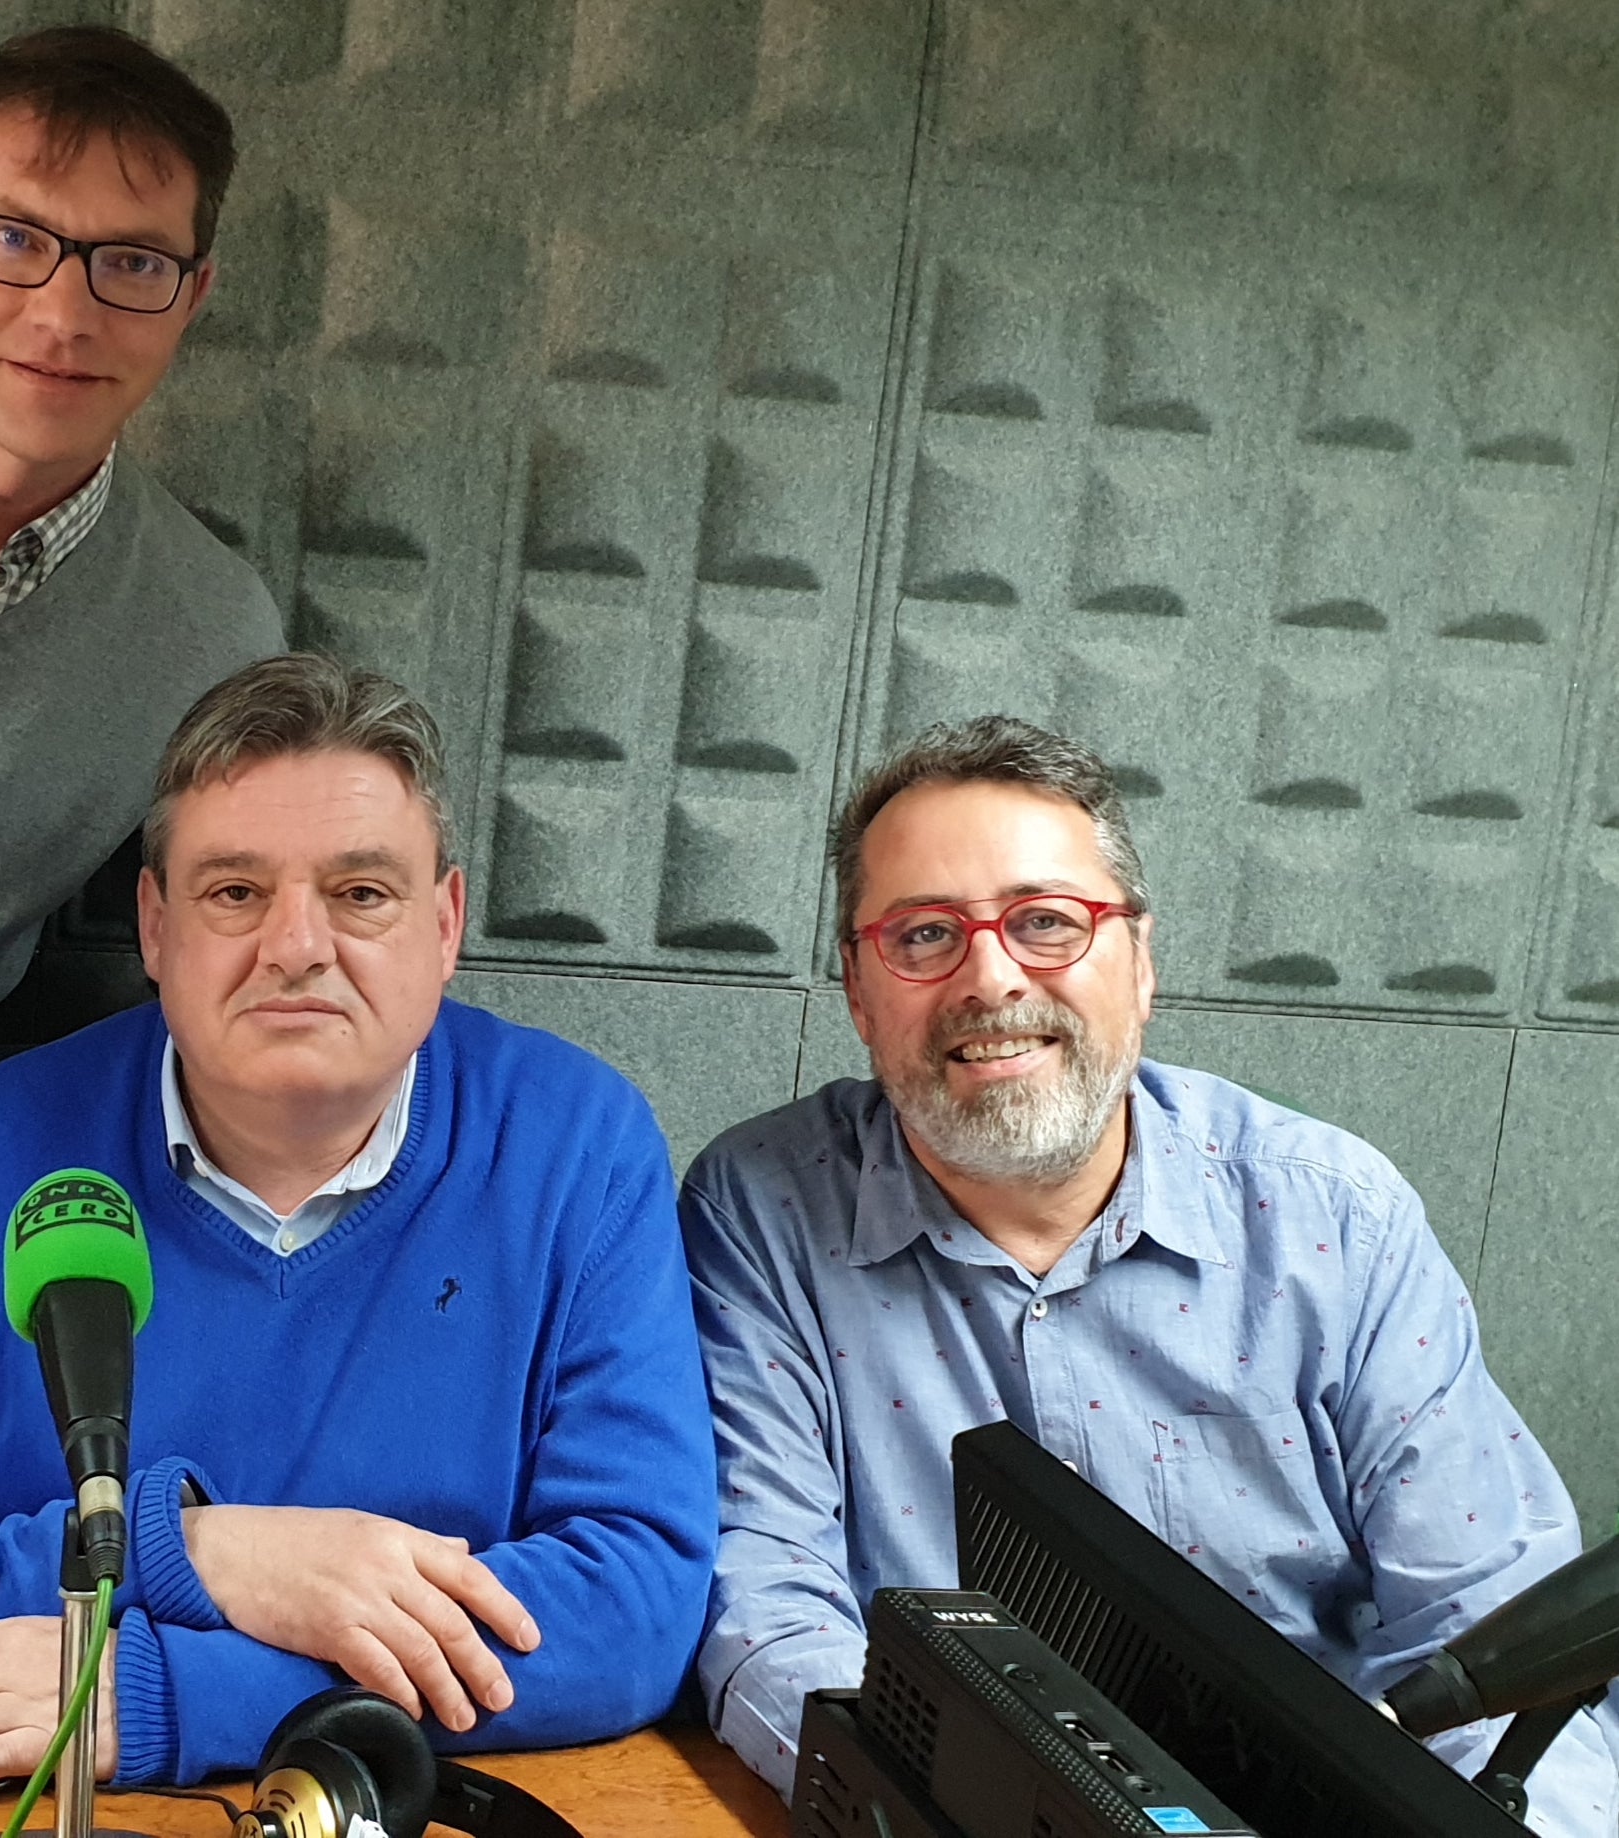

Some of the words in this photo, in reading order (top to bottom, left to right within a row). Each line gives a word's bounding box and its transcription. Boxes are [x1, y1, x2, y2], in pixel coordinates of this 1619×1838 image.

[28, 1185, 116, 1207] ONDA
[33, 1203, 118, 1225] CERO
[932, 1611, 998, 1623] WYSE
